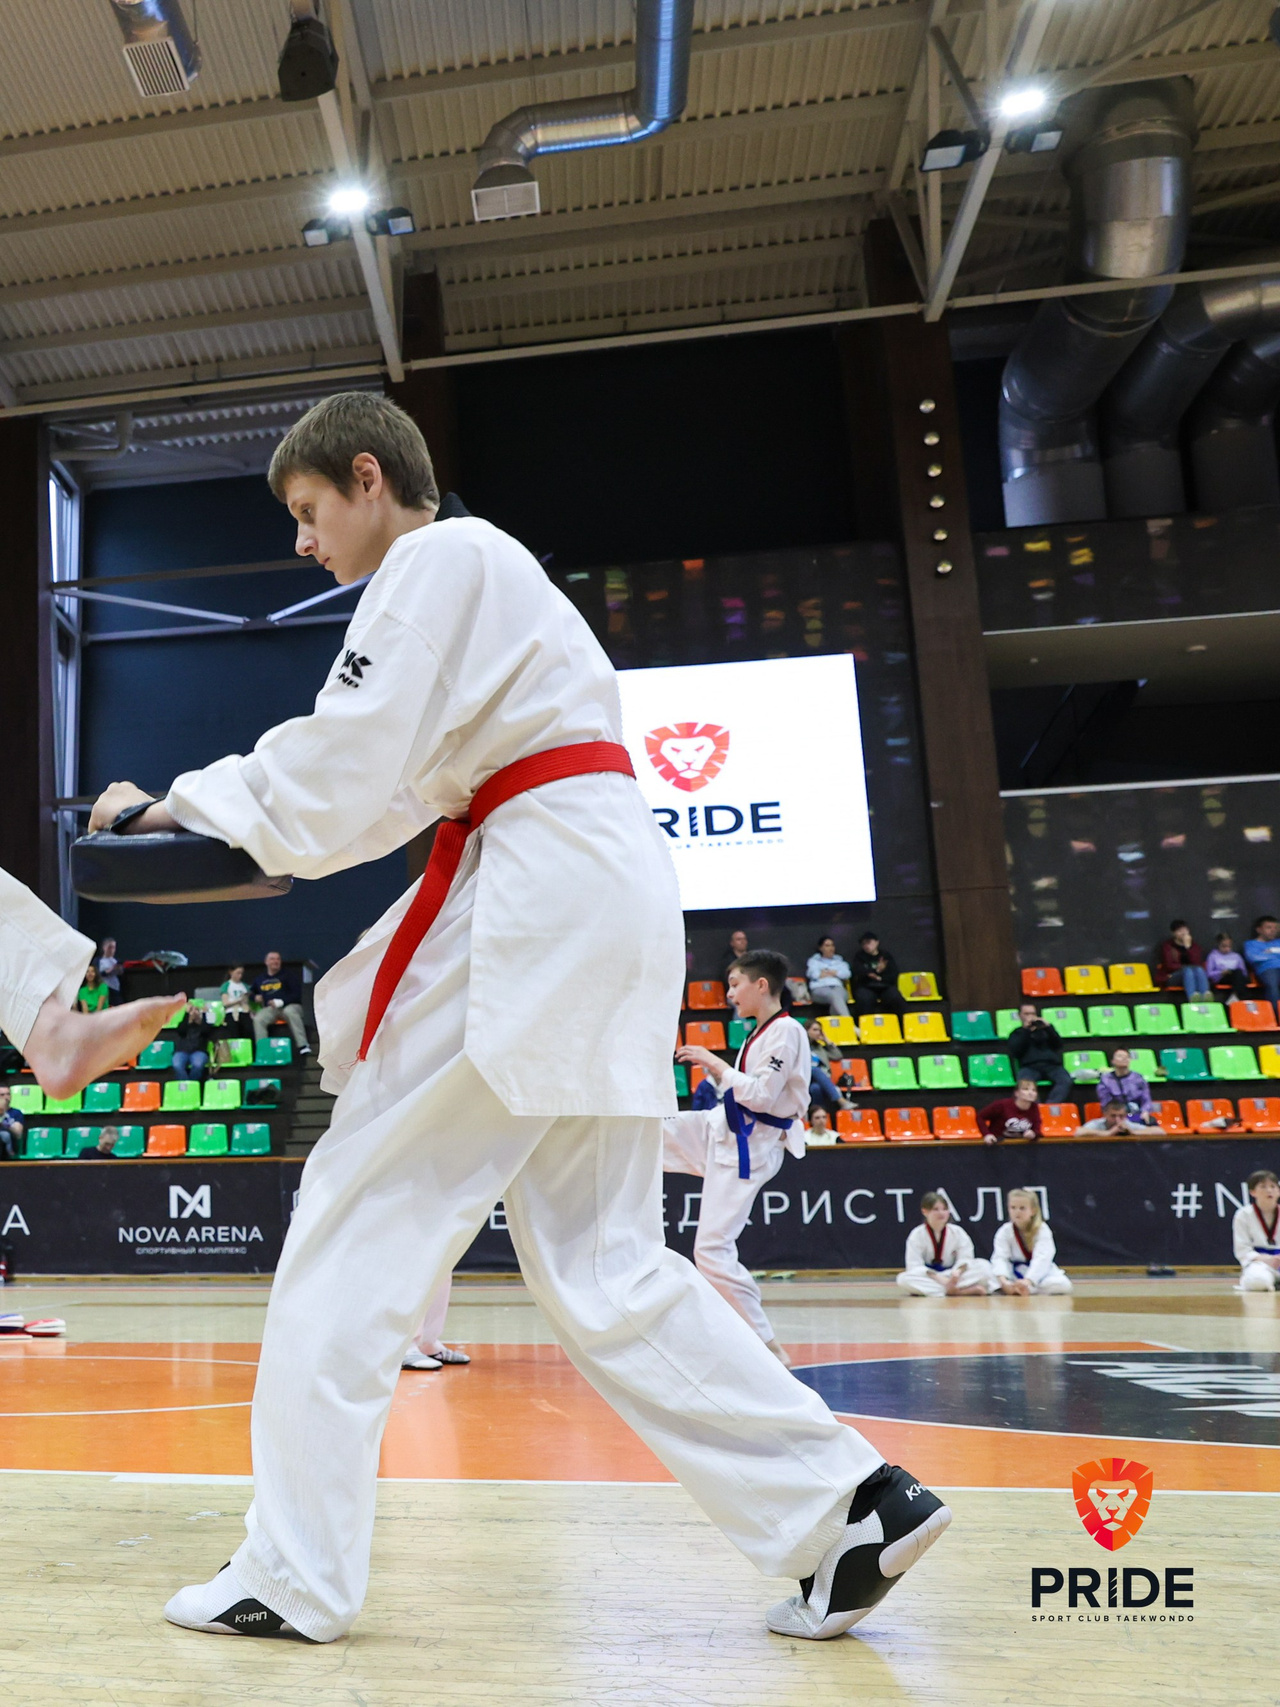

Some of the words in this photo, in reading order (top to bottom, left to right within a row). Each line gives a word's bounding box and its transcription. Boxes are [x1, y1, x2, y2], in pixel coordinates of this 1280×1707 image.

[651, 801, 783, 838] RIDE
[118, 1226, 181, 1244] NOVA
[185, 1225, 264, 1243] ARENA
